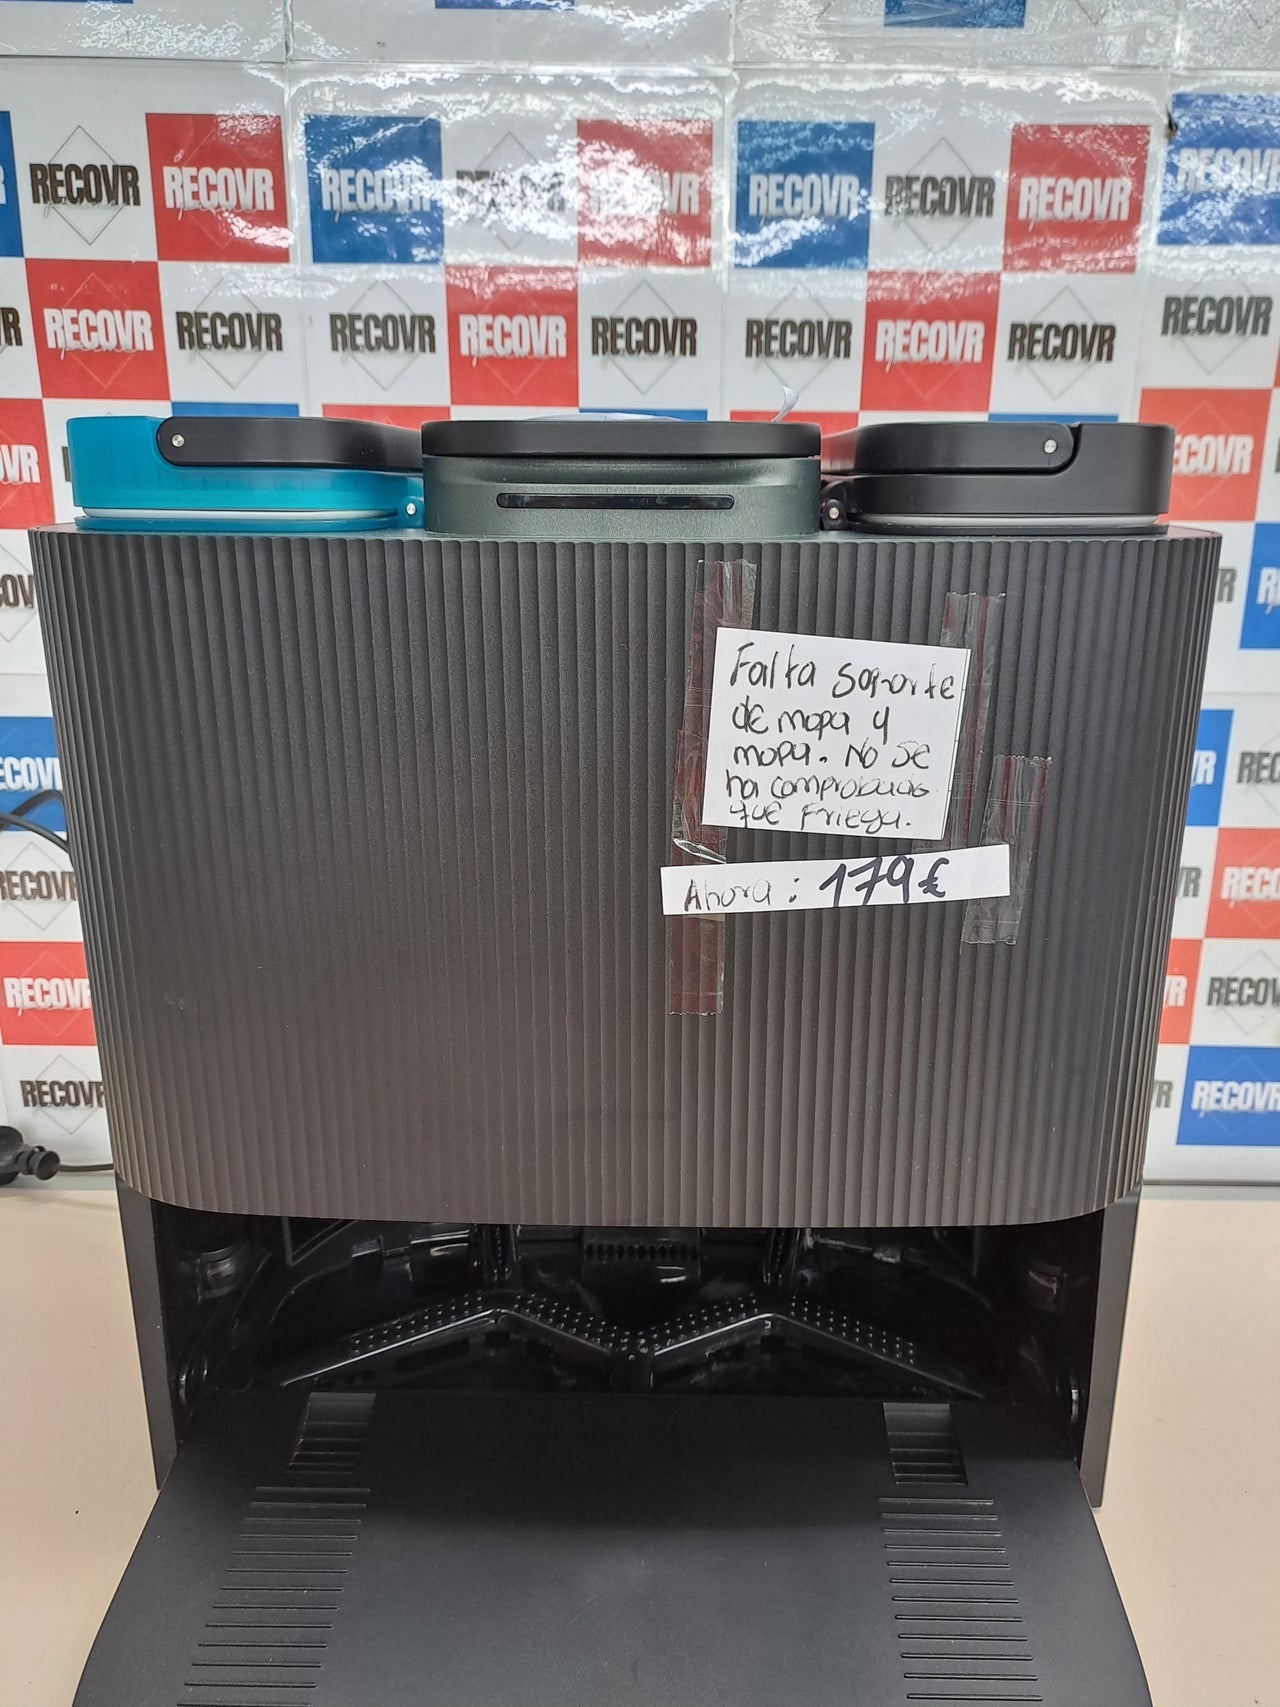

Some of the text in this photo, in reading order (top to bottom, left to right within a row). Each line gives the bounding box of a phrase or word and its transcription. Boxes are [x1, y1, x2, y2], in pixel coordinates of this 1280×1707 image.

[29, 163, 141, 206] RECOVR
[163, 166, 275, 211] RECOVR
[748, 173, 860, 217] RECOVR
[884, 175, 996, 217] RECOVR
[1018, 177, 1131, 221] RECOVR
[43, 308, 154, 351] RECOVR
[176, 311, 284, 352] RECOVR
[329, 312, 437, 354] RECOVR
[459, 314, 568, 358] RECOVR
[591, 317, 697, 357] RECOVR
[1161, 296, 1273, 336] RECOVR
[745, 319, 852, 359] RECOVR
[875, 320, 985, 363] RECOVR
[1007, 323, 1116, 362] RECOVR
[730, 642, 818, 689] Falta
[732, 695, 890, 745] de mopa y
[844, 736, 878, 769] No
